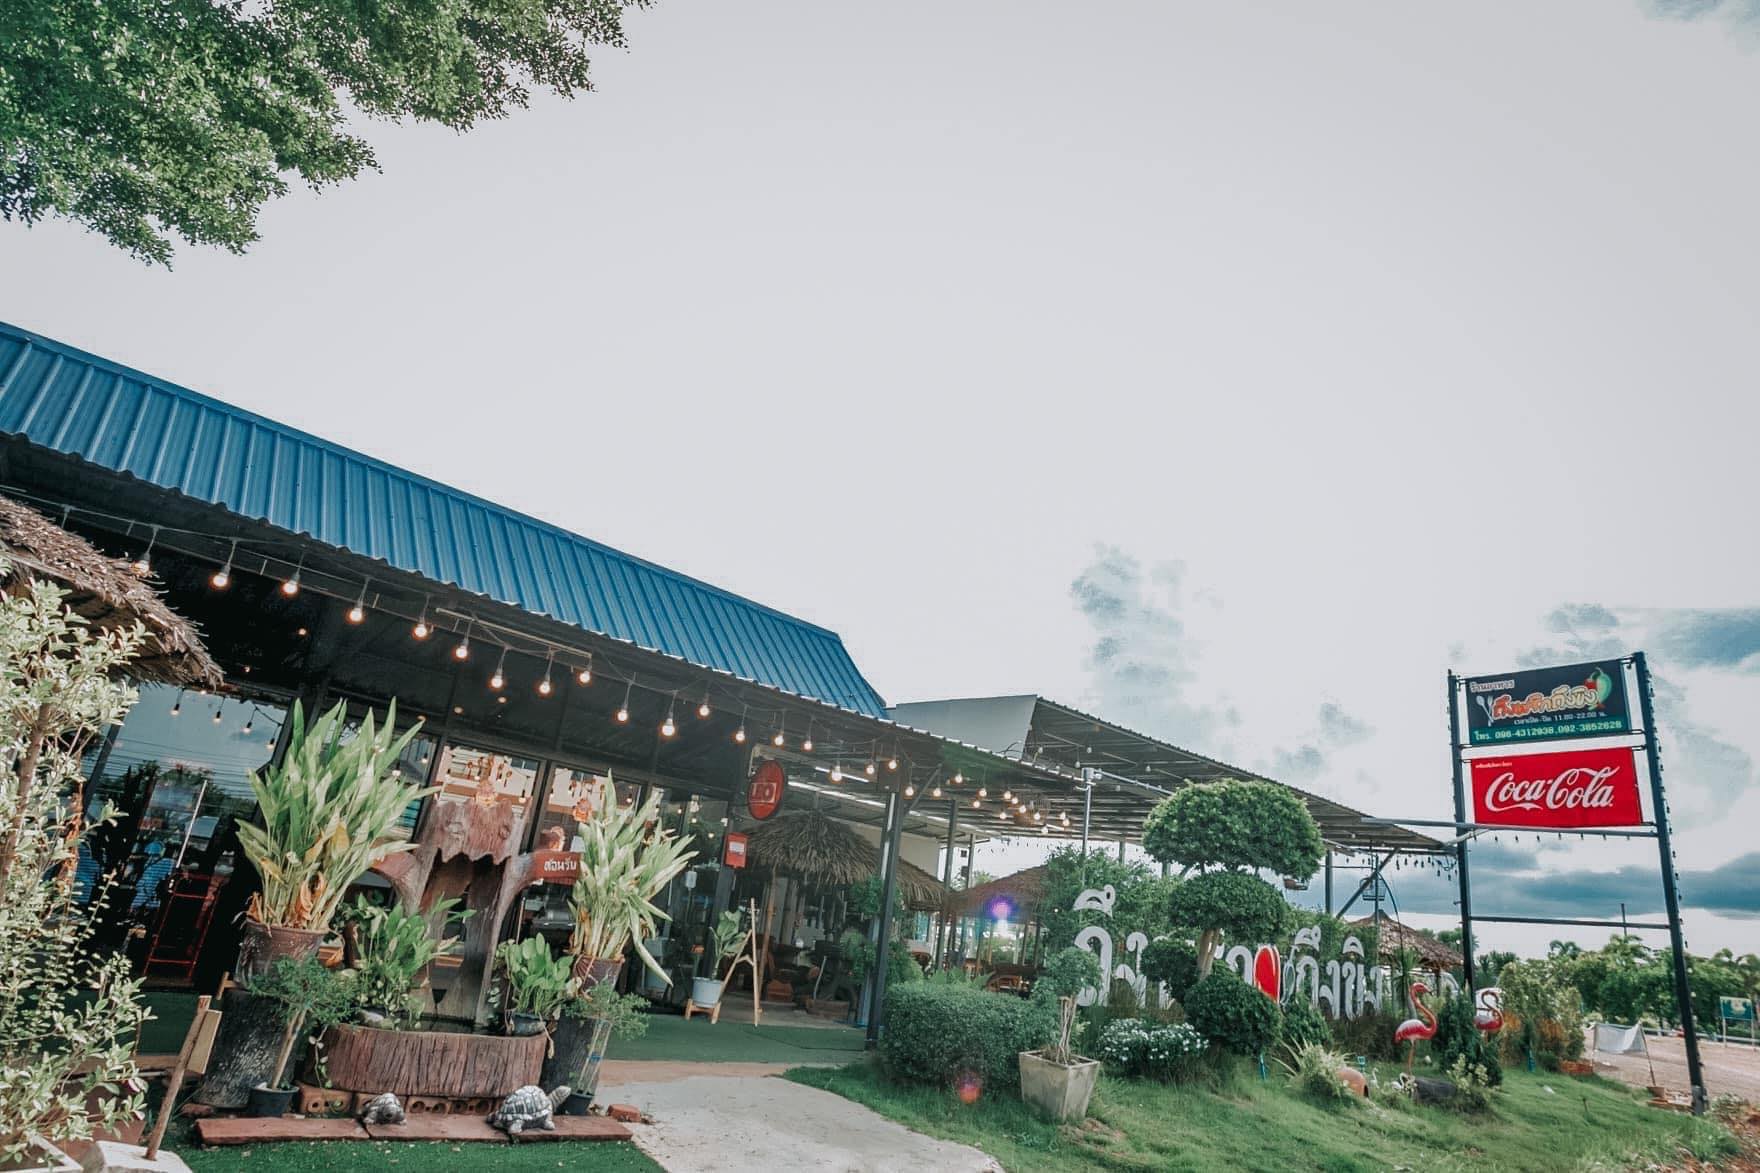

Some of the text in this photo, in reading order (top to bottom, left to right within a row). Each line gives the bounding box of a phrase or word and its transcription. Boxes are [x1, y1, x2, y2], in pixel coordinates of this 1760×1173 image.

[751, 784, 775, 802] LEO
[1485, 766, 1620, 812] Coca-Cola
[544, 857, 577, 872] ต้อนรับ
